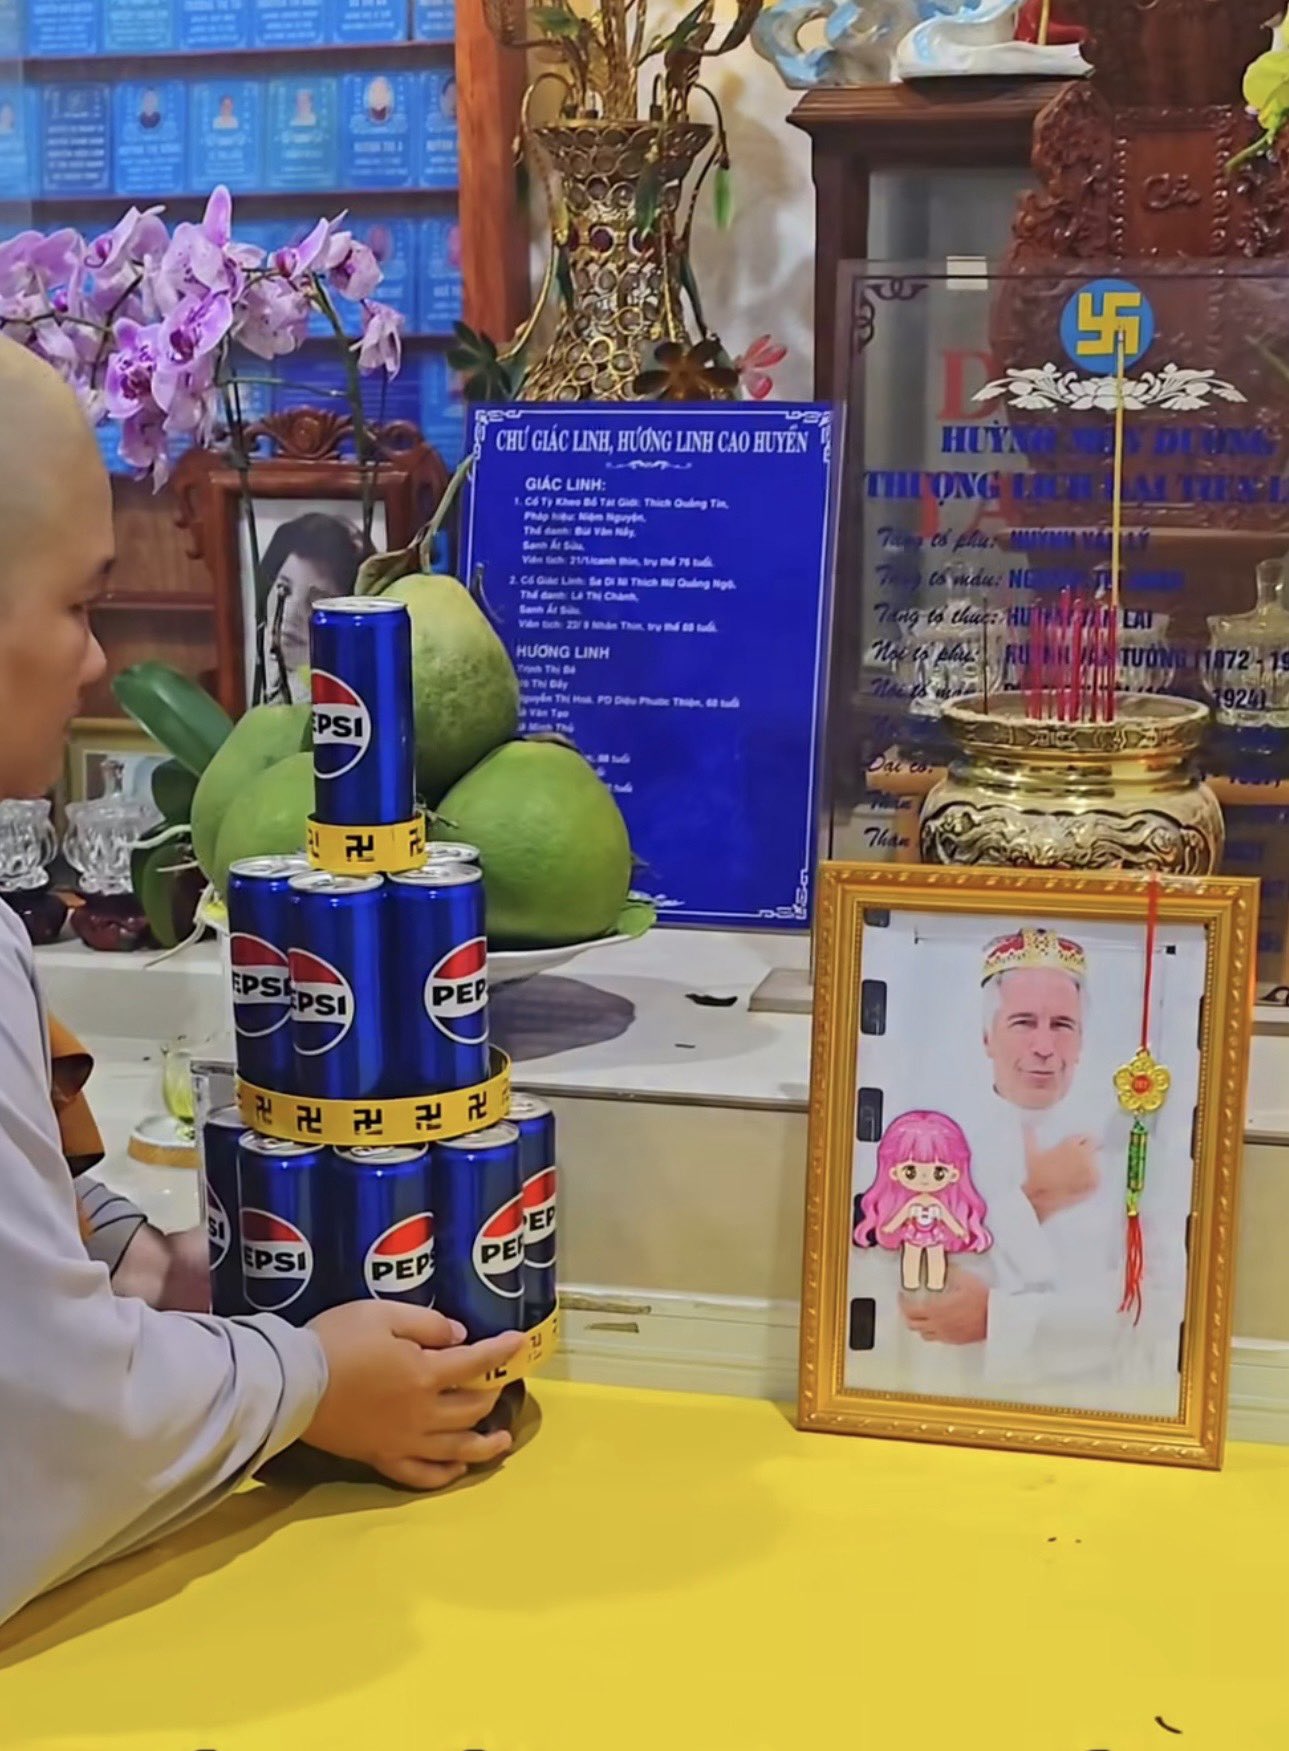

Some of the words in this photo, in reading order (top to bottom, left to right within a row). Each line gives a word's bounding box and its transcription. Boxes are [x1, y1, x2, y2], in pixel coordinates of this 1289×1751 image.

[531, 424, 569, 452] GIÁC
[572, 430, 613, 456] LINH,
[676, 430, 714, 453] LINH
[718, 430, 750, 453] CAO
[525, 475, 562, 491] GIÁC
[566, 478, 606, 491] LINH:
[516, 643, 570, 659] HƯƠNG
[574, 646, 610, 659] LINH
